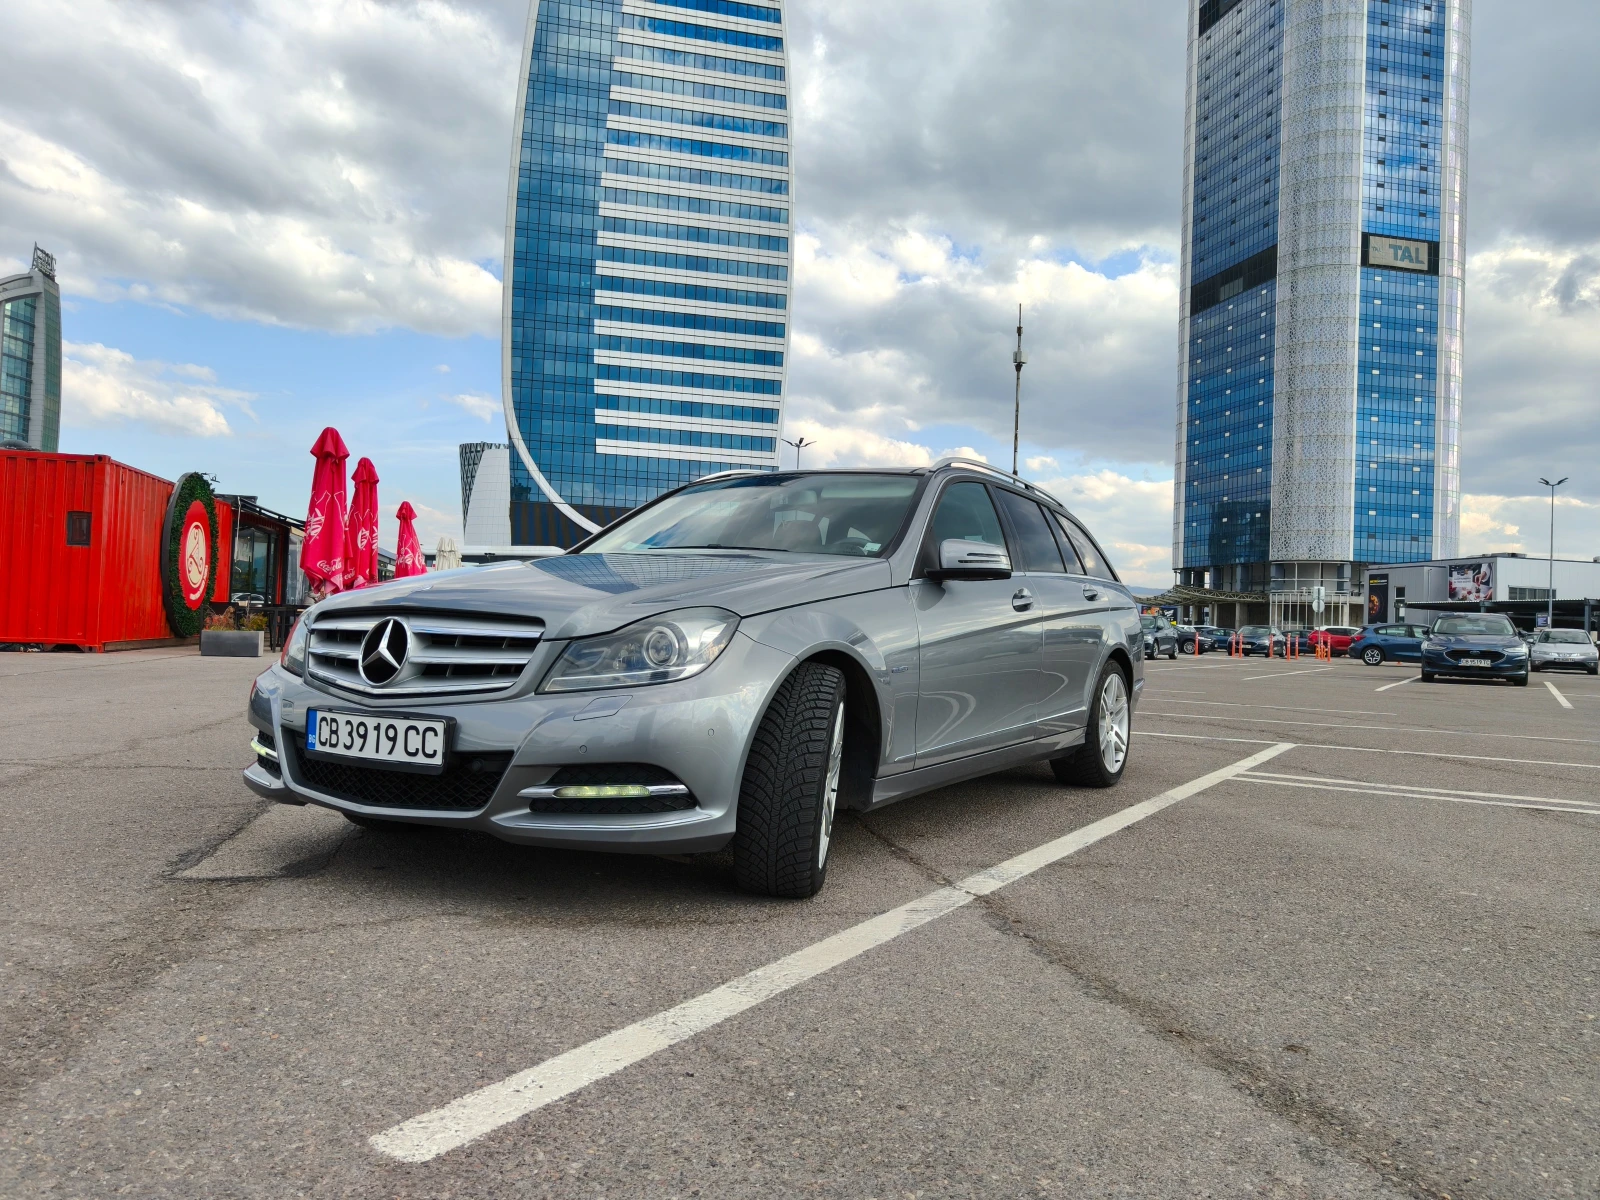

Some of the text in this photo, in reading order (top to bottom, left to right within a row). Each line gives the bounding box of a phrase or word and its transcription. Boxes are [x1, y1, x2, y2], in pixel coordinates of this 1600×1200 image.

[1389, 244, 1425, 264] TAL
[317, 556, 342, 575] CocaCola
[308, 734, 316, 743] BG
